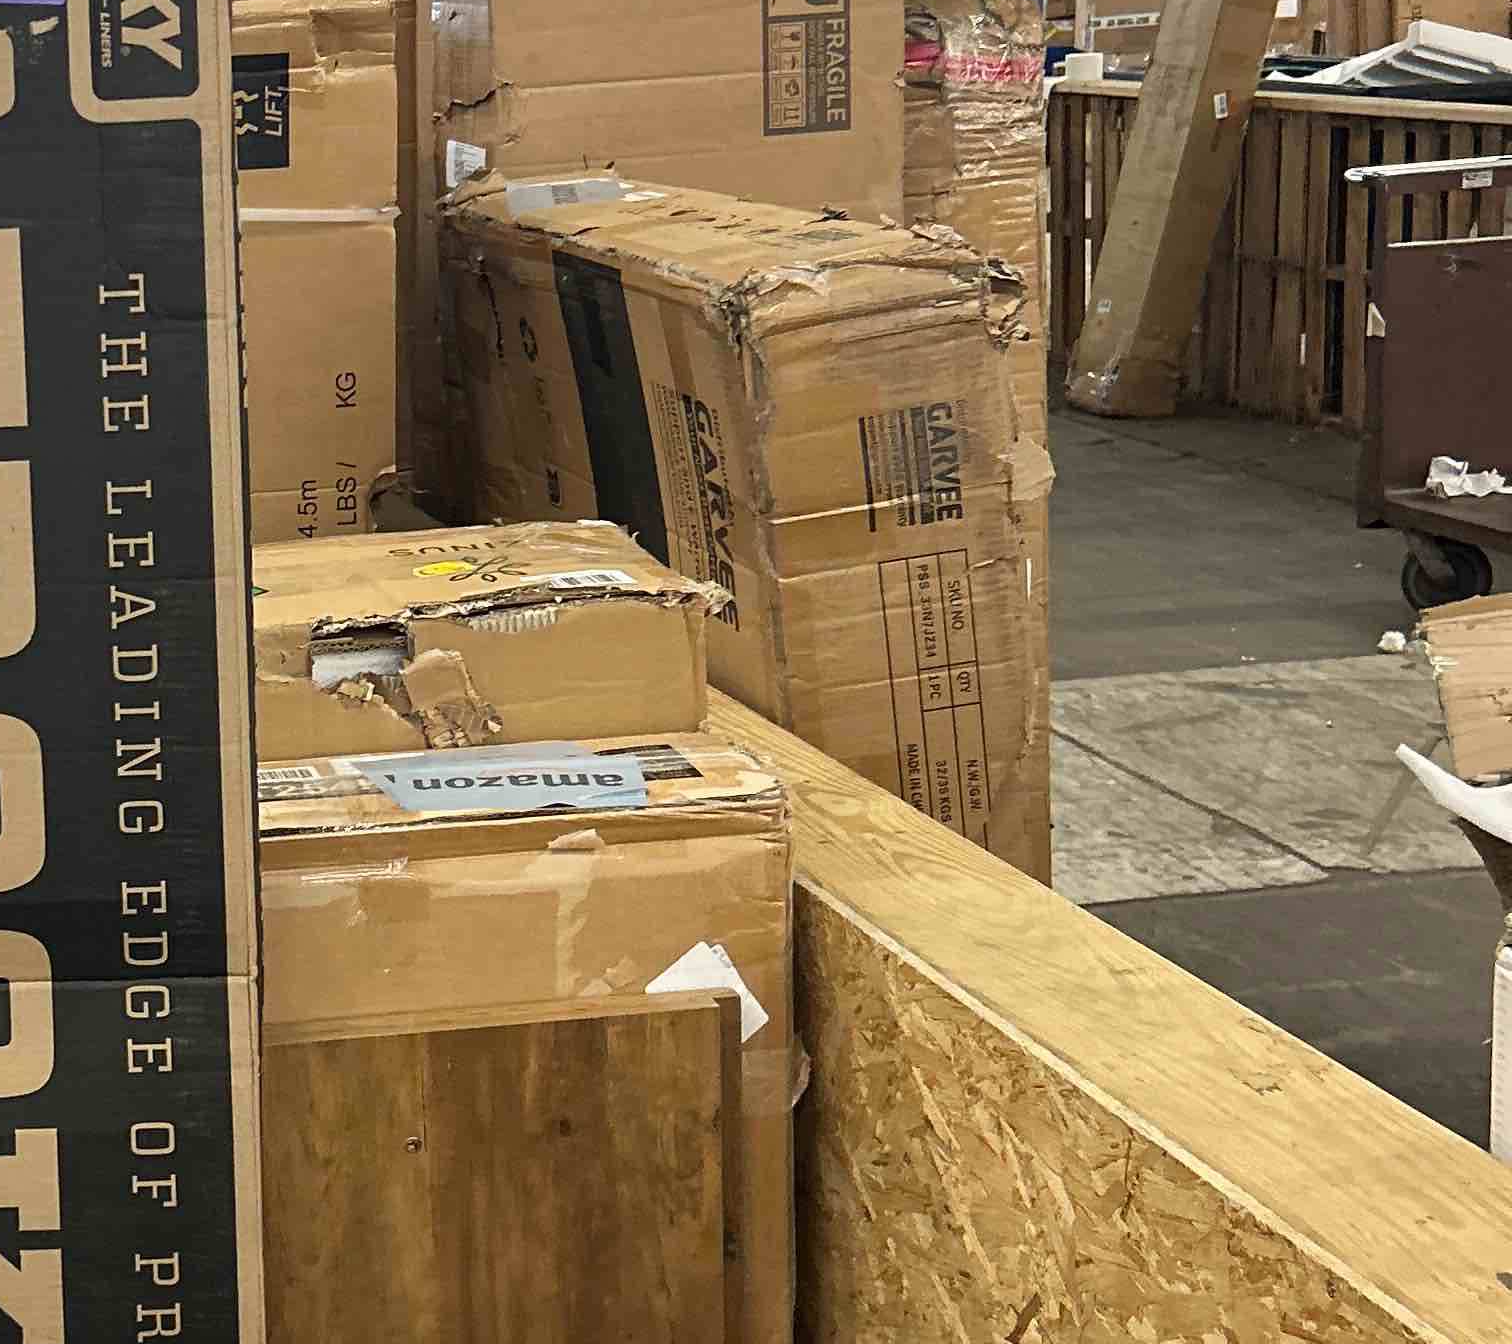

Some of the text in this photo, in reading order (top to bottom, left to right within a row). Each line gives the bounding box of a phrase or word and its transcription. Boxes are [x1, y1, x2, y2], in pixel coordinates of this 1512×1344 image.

[99, 12, 113, 69] LINERS
[825, 18, 848, 122] FRAGILE
[264, 86, 284, 137] LIFT
[97, 273, 152, 434] THE
[335, 371, 357, 409] KG
[924, 400, 963, 522] GARVEE
[297, 480, 319, 539] 4.5m
[336, 476, 358, 526] LBS
[694, 400, 740, 632] GARVEE
[104, 479, 164, 834] LEADING
[956, 670, 972, 694] QTY
[927, 682, 940, 700] PC
[413, 772, 625, 792] amazon
[903, 742, 921, 776] MADE
[907, 777, 922, 790] IN
[120, 880, 175, 1075] EDGE
[129, 1121, 177, 1208] OF
